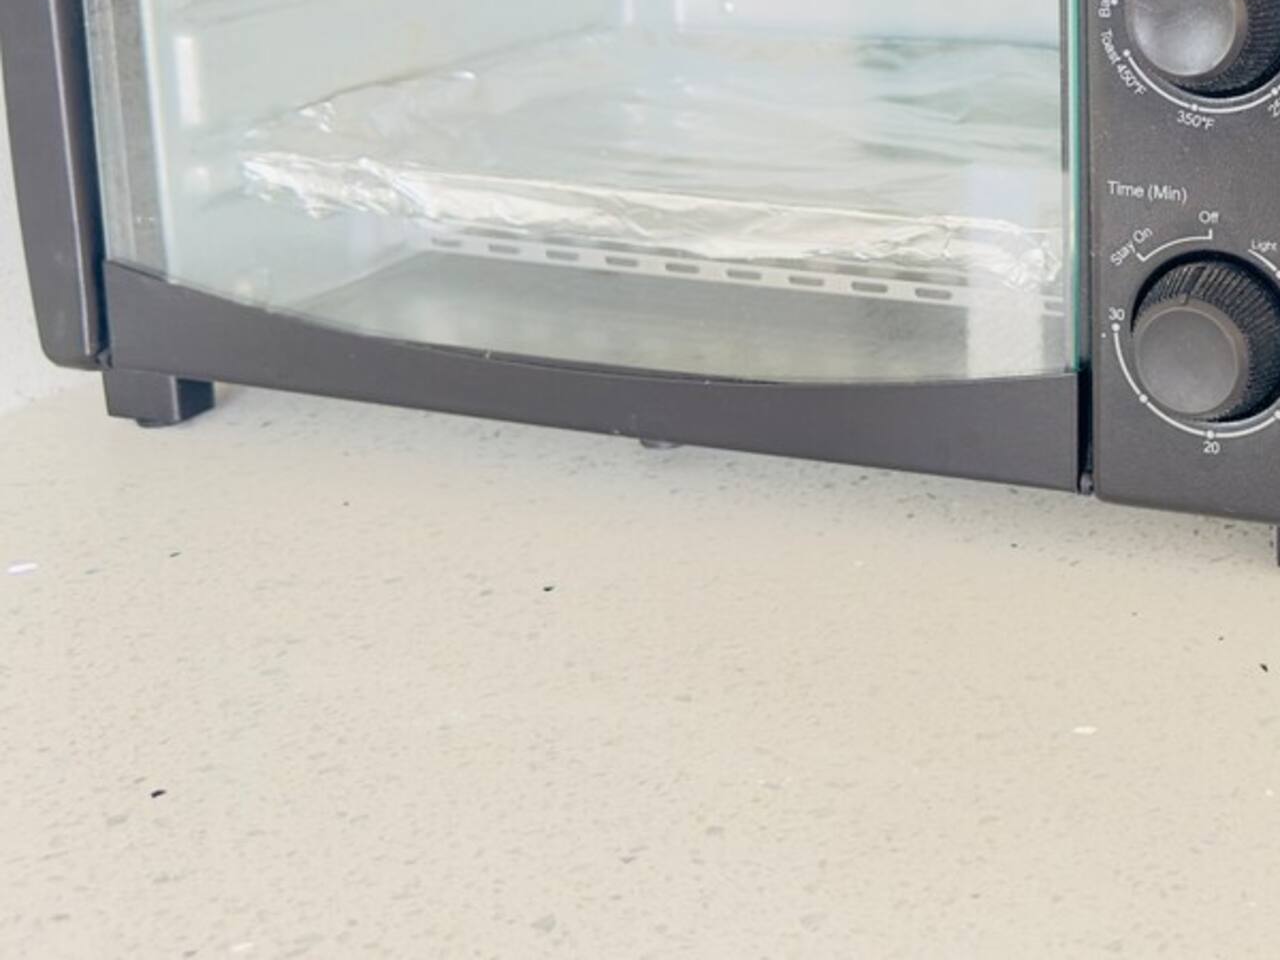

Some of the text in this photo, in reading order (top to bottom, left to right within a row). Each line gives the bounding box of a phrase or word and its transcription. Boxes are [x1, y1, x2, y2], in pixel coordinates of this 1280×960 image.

[1099, 28, 1122, 65] Toast
[1116, 58, 1148, 96] 450°F
[1176, 109, 1216, 130] 350°F
[1107, 180, 1188, 205] Time (Min)
[1199, 210, 1220, 225] Off
[1110, 226, 1153, 267] Stay On
[1250, 240, 1278, 253] Light
[1108, 308, 1126, 321] 30
[1203, 441, 1221, 455] 20
